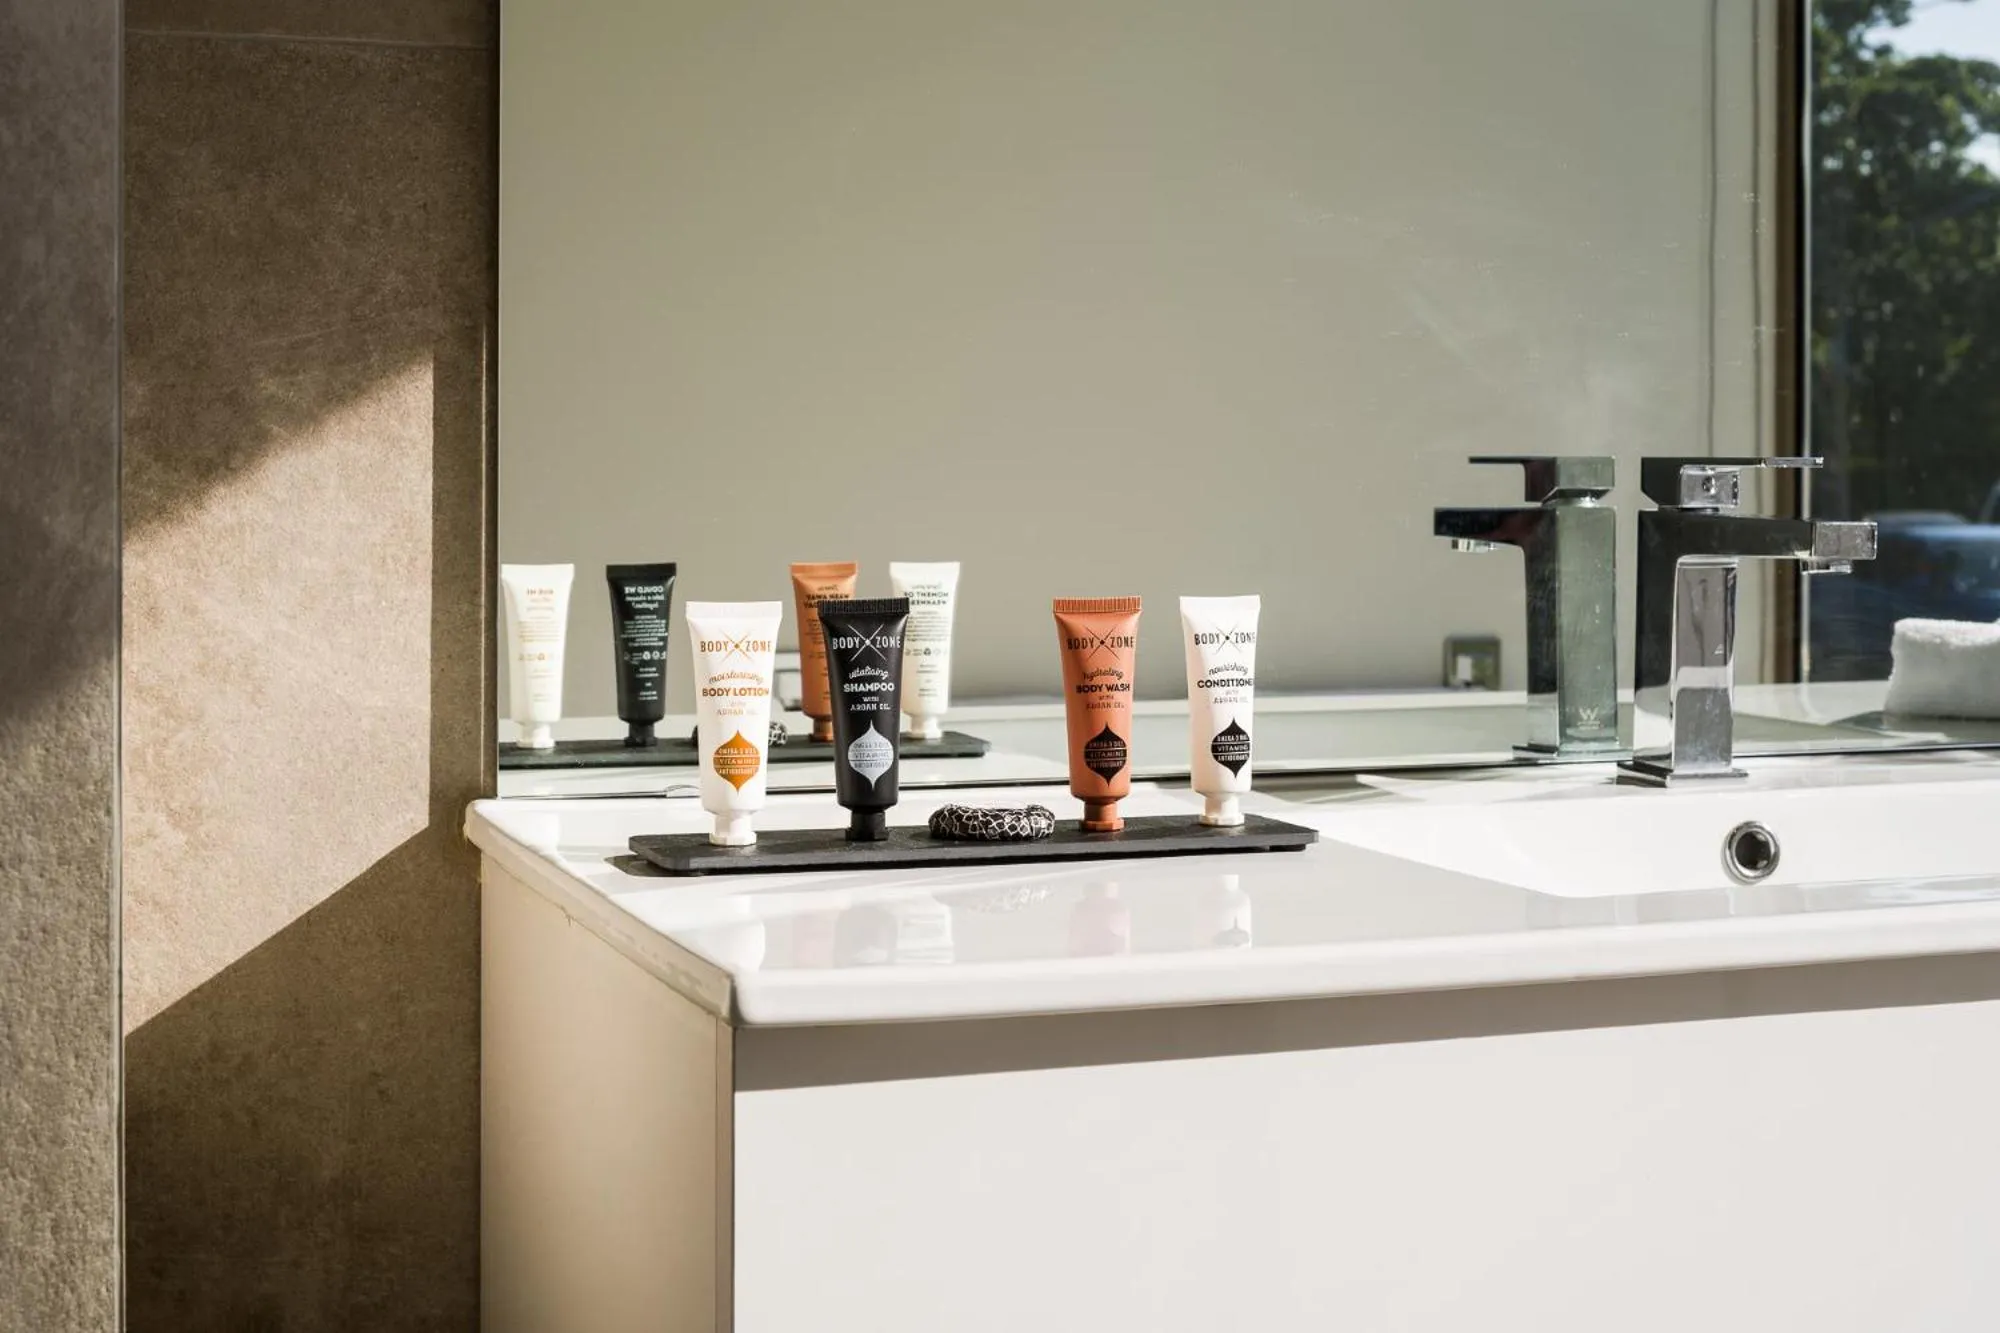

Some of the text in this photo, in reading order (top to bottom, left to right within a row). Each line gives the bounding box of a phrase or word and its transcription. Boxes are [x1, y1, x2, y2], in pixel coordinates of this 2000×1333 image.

[832, 635, 901, 649] BODY ZONE
[1067, 636, 1134, 650] BODY ZONE
[1194, 631, 1256, 645] BODY ZONE
[700, 640, 772, 652] BODY ZONE
[1082, 667, 1124, 681] hydrating
[1208, 662, 1249, 675] nourishing
[843, 682, 895, 692] SHAMPOO
[1076, 683, 1130, 693] BODY WASH
[1197, 678, 1254, 688] CONDITIONE
[702, 687, 769, 697] BODY LOTION
[850, 703, 877, 711] ARGAN
